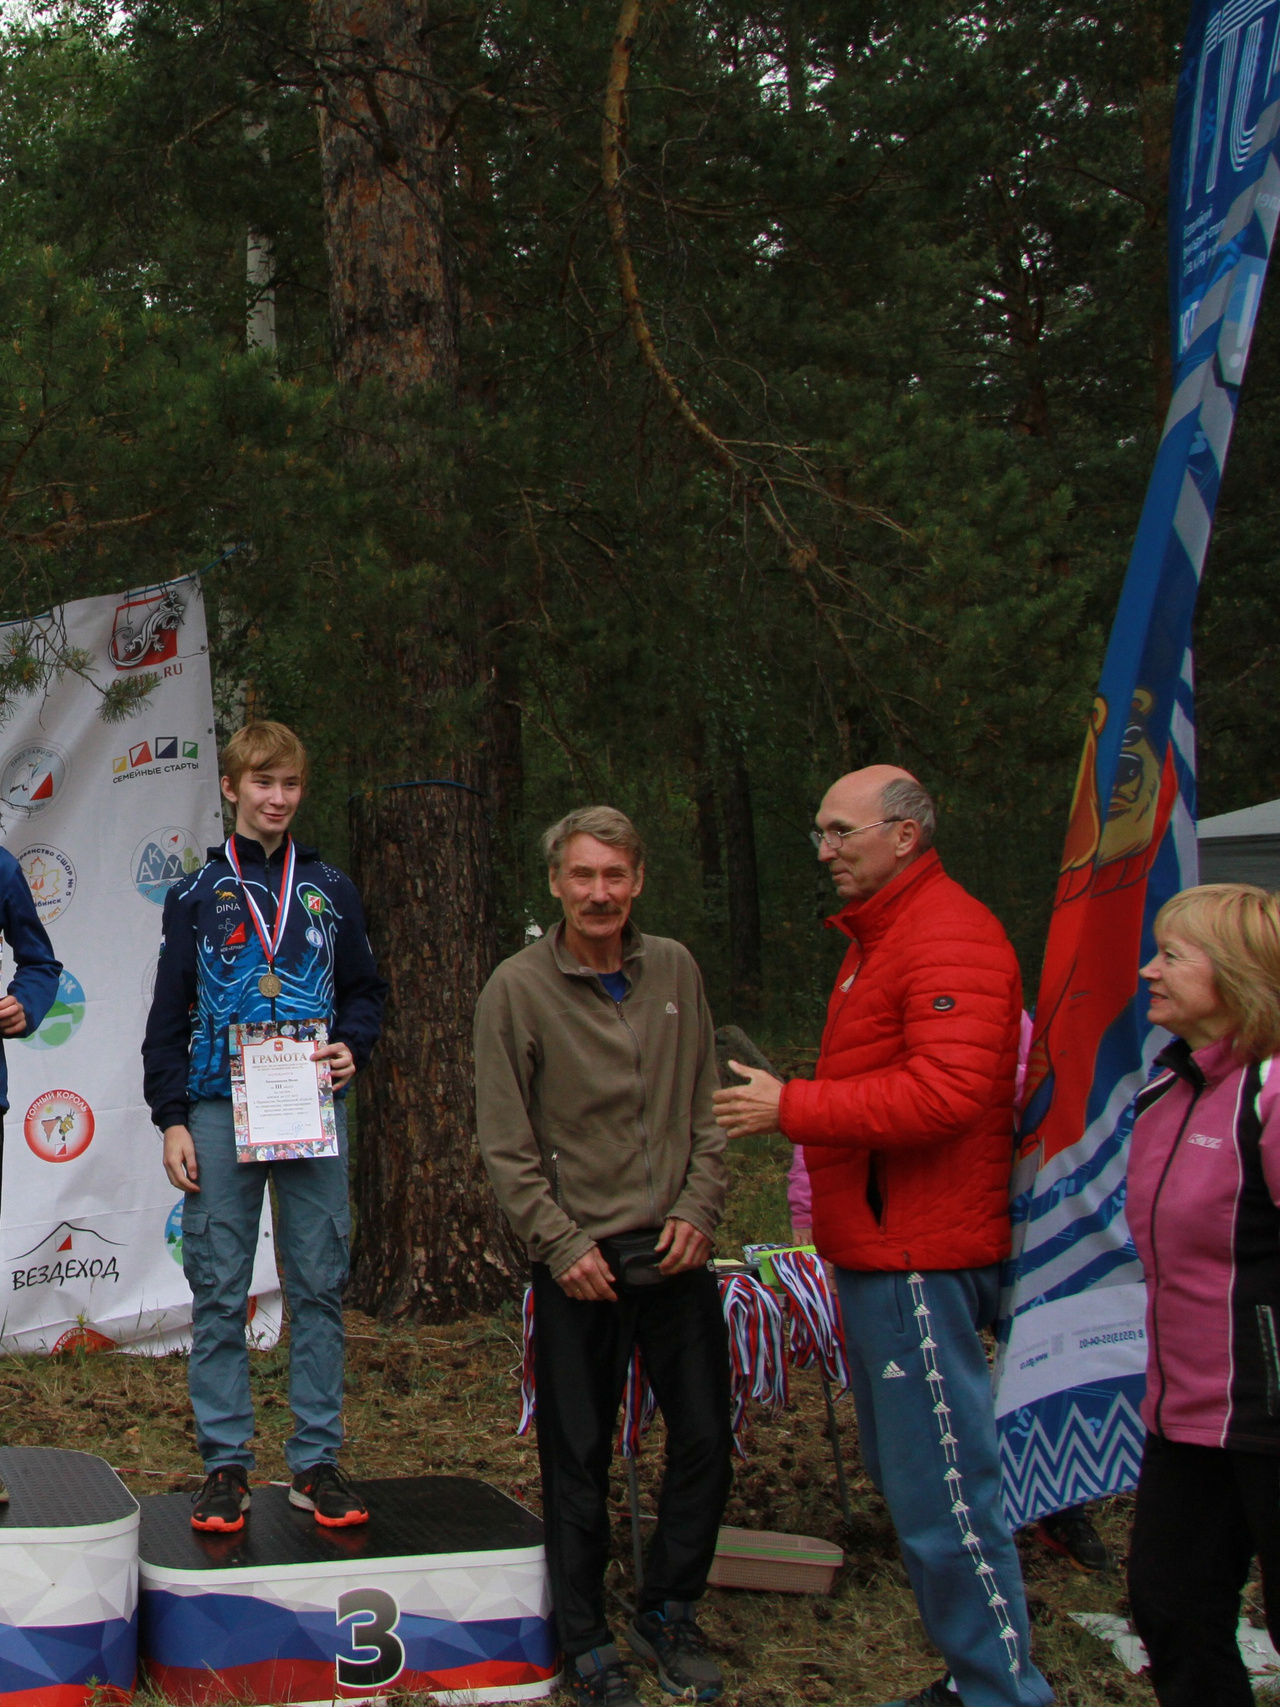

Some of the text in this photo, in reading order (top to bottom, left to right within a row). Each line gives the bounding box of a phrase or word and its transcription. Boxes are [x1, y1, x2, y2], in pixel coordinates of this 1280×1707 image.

[112, 762, 199, 784] СЕМЕЙНЫЕ СТАРТЫ
[18, 848, 55, 862] рвенство
[56, 854, 73, 876] СШОР
[34, 898, 62, 908] бинск
[216, 903, 241, 914] DINA
[251, 1052, 308, 1064] ГРАМОТА
[26, 1090, 88, 1120] ГОРНЫЙ КОРОЛЬ
[11, 1256, 120, 1291] ВЕЗДЕХОД
[882, 1370, 906, 1379] adidas
[336, 1588, 405, 1688] 3
